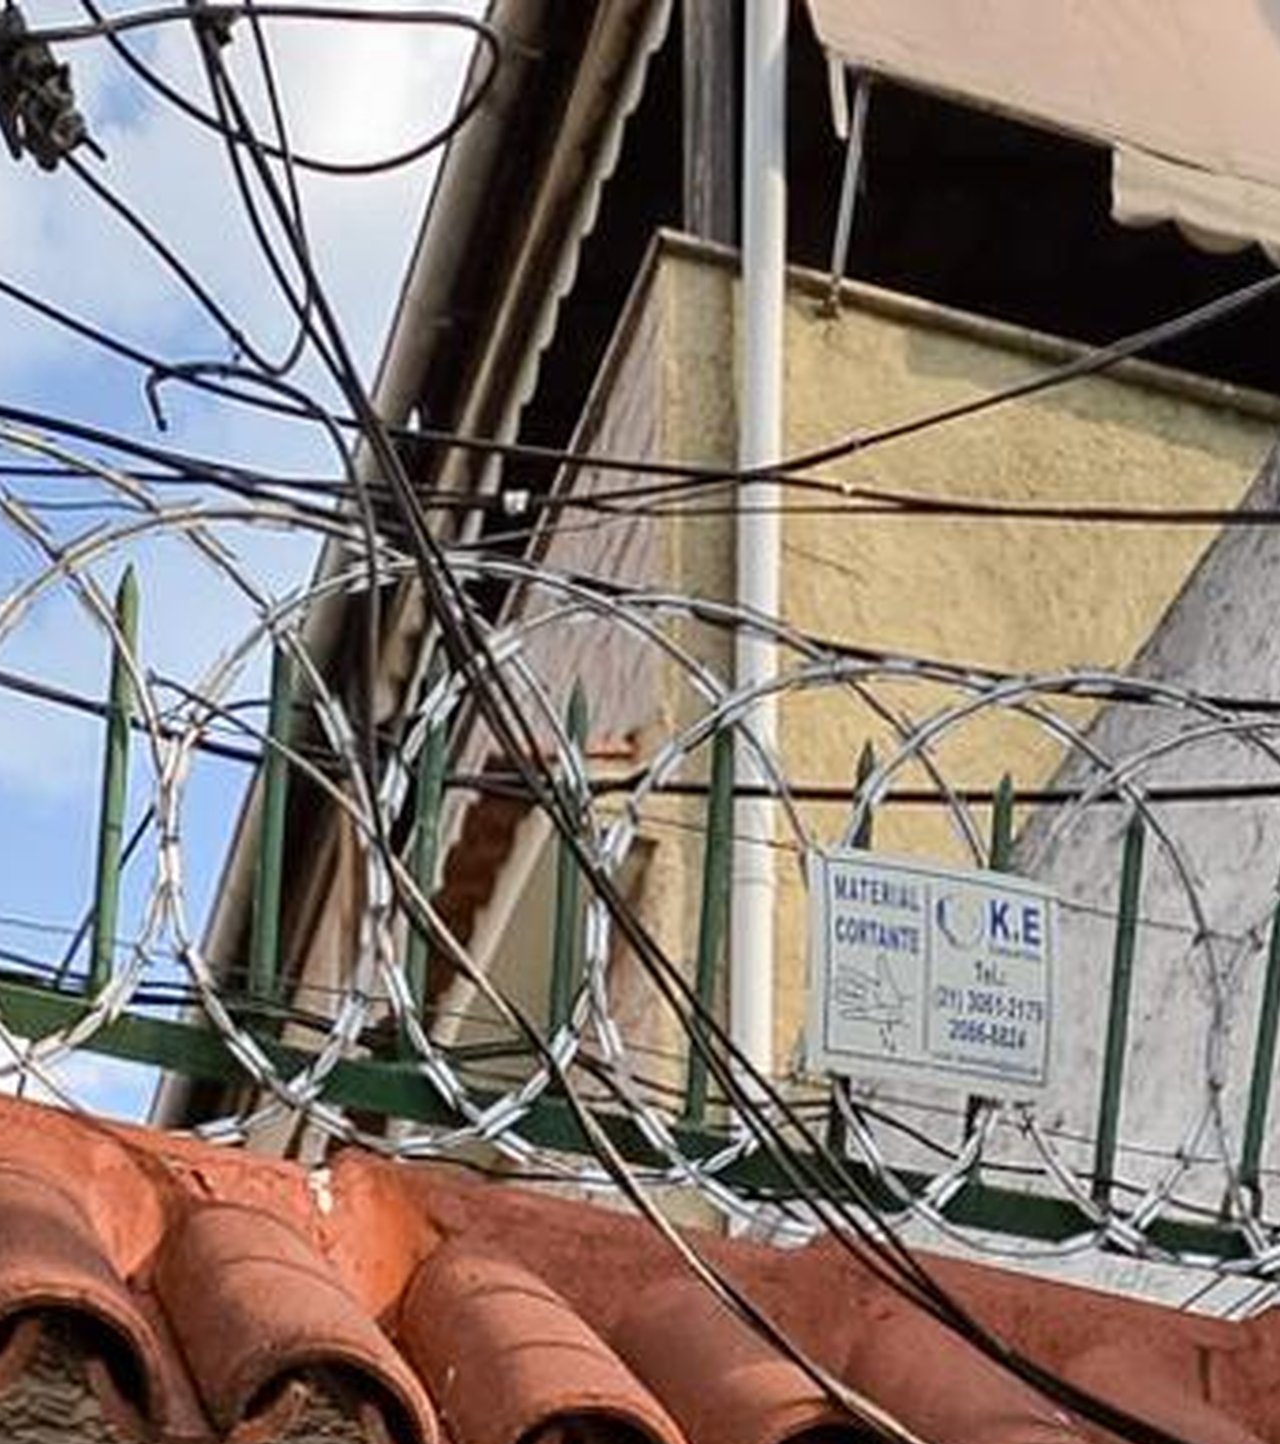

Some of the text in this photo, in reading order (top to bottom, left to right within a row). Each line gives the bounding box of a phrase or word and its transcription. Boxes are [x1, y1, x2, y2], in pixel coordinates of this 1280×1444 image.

[834, 873, 920, 912] MATERIAL
[835, 914, 919, 955] CORTANTE
[990, 898, 1041, 946] K.E
